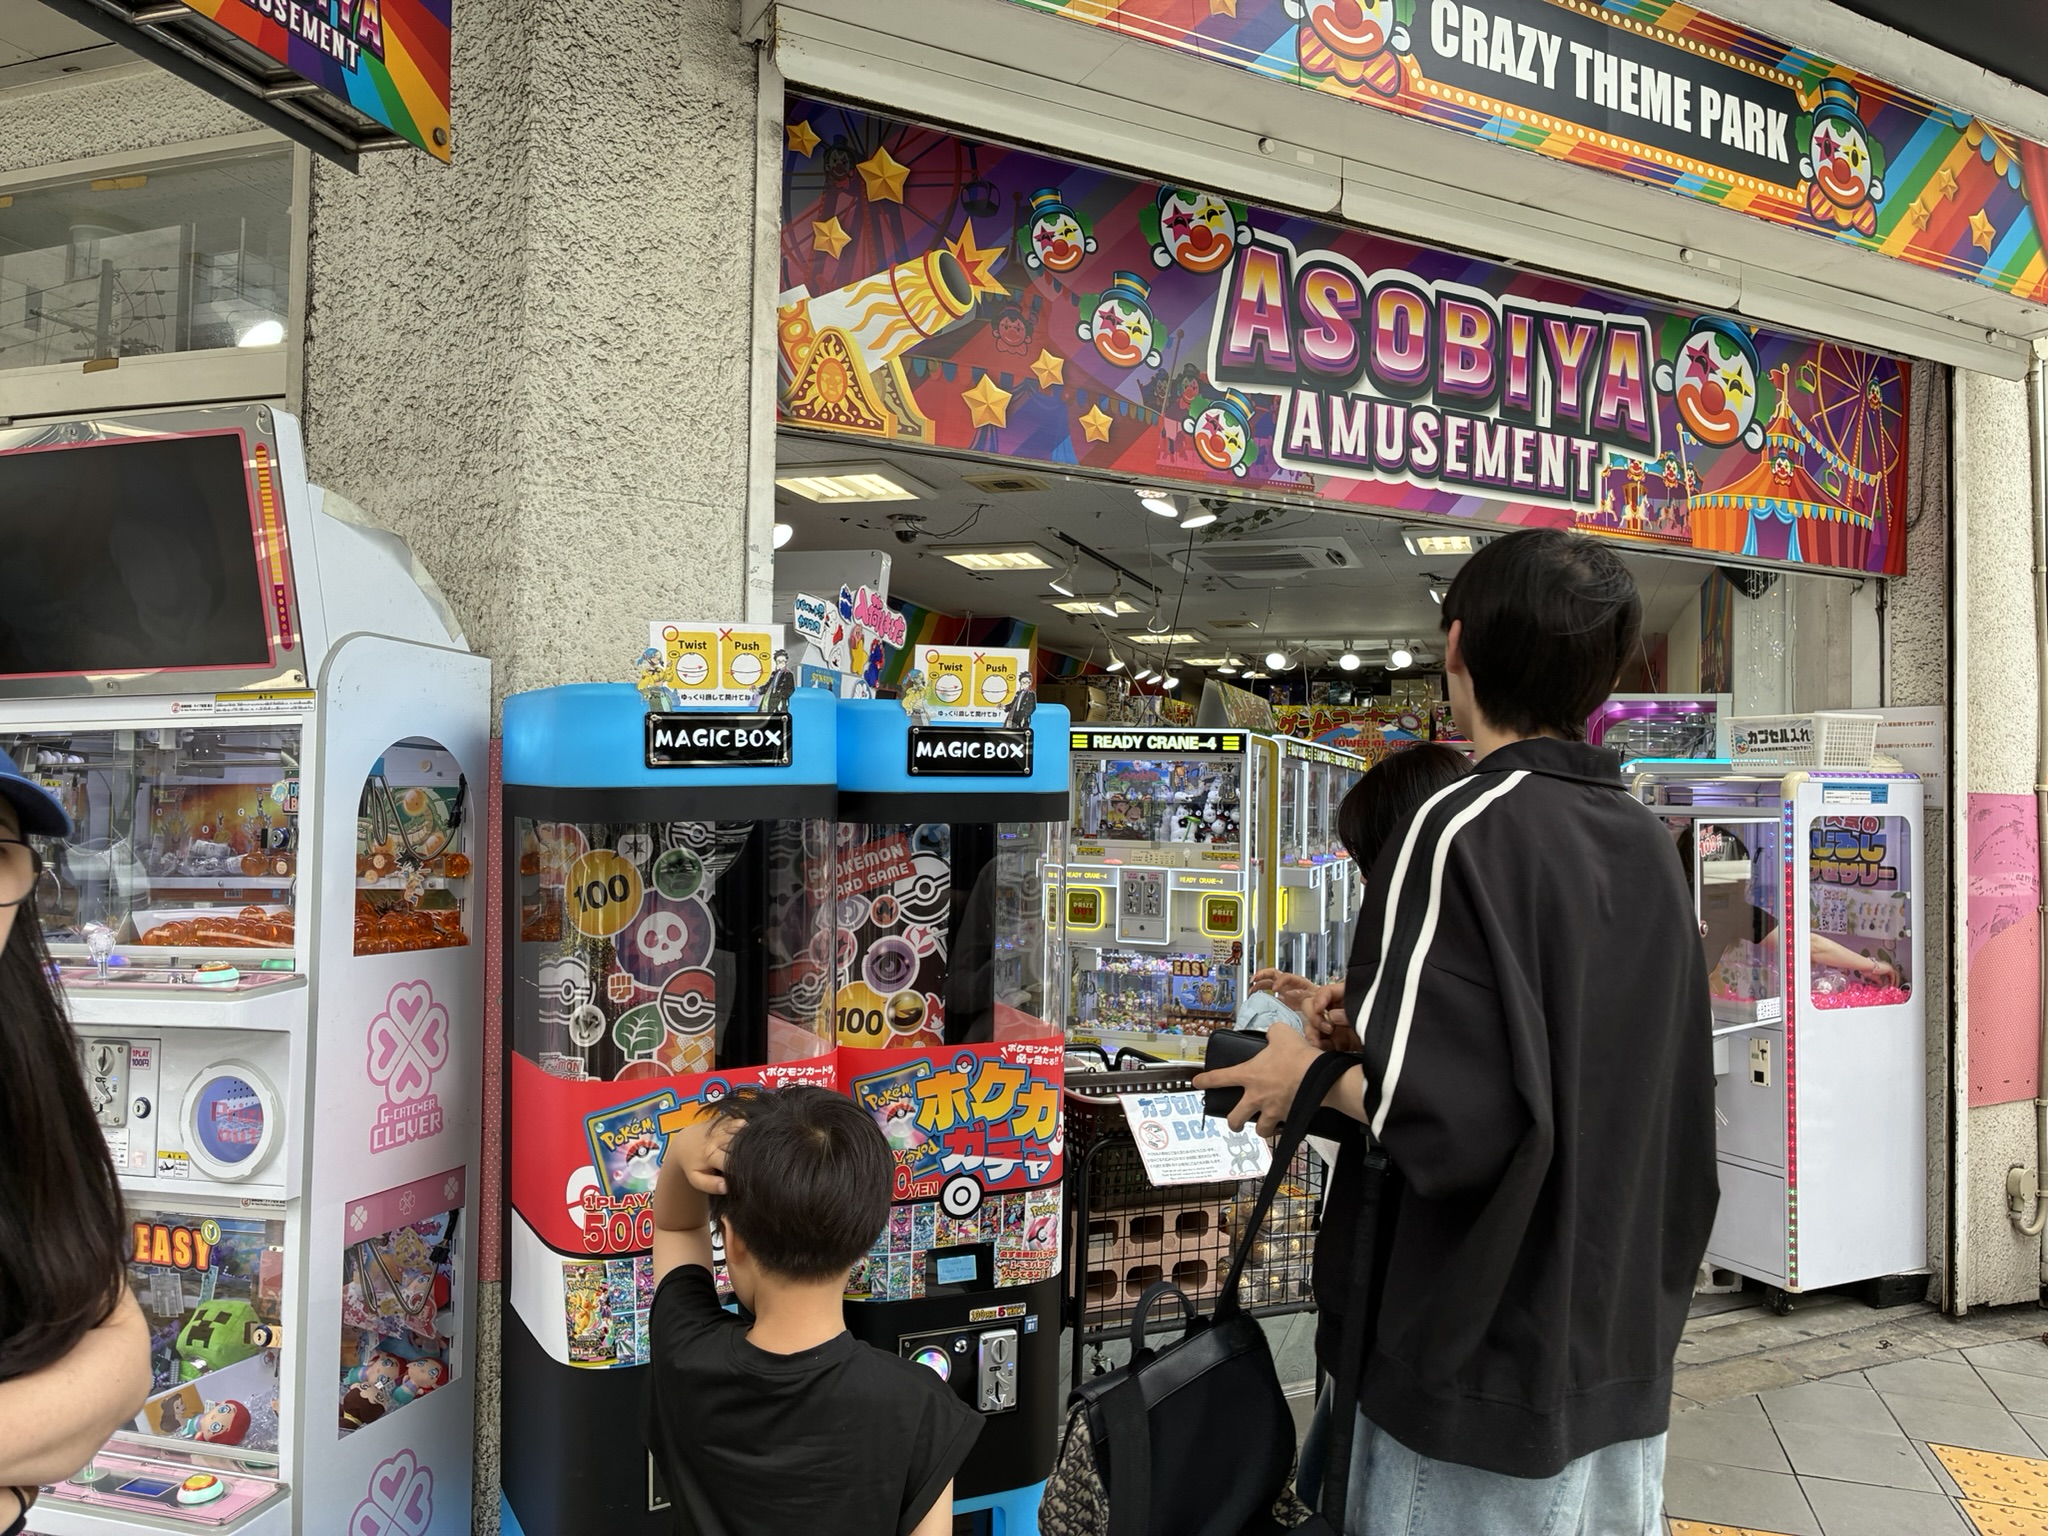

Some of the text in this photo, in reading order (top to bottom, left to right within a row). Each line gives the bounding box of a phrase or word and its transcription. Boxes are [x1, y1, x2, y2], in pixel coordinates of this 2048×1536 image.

[247, 0, 360, 69] USEMENT
[1431, 0, 1790, 165] CRAZY THEME PARK
[1224, 247, 1648, 440] ASOBIYA
[1289, 390, 1599, 493] AMUSEMENT
[678, 640, 707, 650] Twist
[735, 641, 760, 651] Push
[938, 662, 963, 672] Twist
[985, 664, 1008, 673] Push
[1279, 707, 1401, 736] ゲームコーナー
[655, 729, 782, 748] MAGIC BOX
[1093, 735, 1144, 749] READY
[1333, 738, 1370, 748] TOWER
[1747, 727, 1811, 745] カプセル入れ
[916, 741, 1025, 759] MAGIC BOX
[867, 862, 910, 885] GAME
[574, 874, 631, 914] 100
[1073, 901, 1094, 909] PRIZE
[1212, 909, 1234, 917] PRIZE
[1173, 960, 1210, 977] EASY
[837, 1006, 884, 1036] 100
[132, 1050, 149, 1058] 1PLAY
[132, 1059, 149, 1068] 100円
[915, 1056, 1060, 1141] ポケカ
[1138, 1094, 1203, 1118] カプセル
[380, 1099, 436, 1125] G-CATCHER
[373, 1112, 442, 1151] CLOVER
[1172, 1118, 1221, 1142] BOX
[941, 1123, 1051, 1181] ガチャ
[907, 1181, 940, 1197] YEN
[584, 1191, 650, 1210] 1PLAY
[583, 1209, 654, 1254] 500
[134, 1223, 211, 1271] EASY
